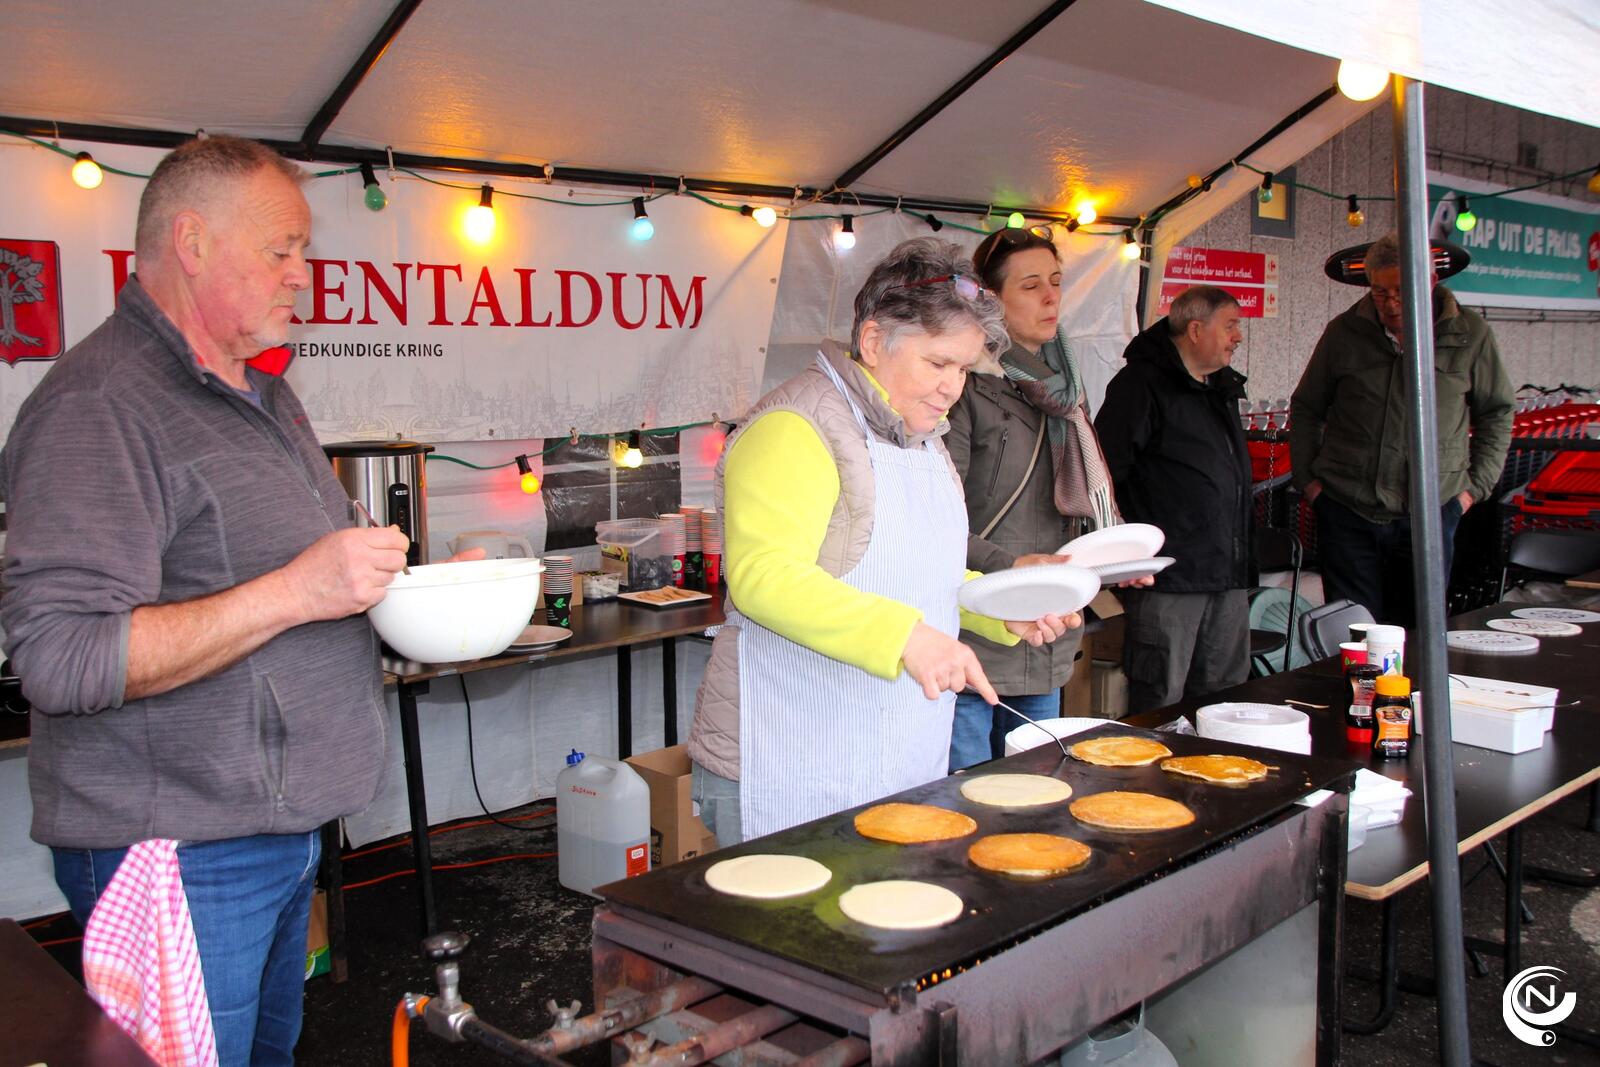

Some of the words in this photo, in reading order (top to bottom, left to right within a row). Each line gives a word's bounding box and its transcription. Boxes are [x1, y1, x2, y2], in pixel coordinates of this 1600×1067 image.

[1498, 222, 1522, 253] UIT
[1524, 225, 1545, 255] DE
[1546, 228, 1582, 259] PRIJS
[102, 249, 708, 330] ENTALDUM
[396, 343, 444, 357] KRING
